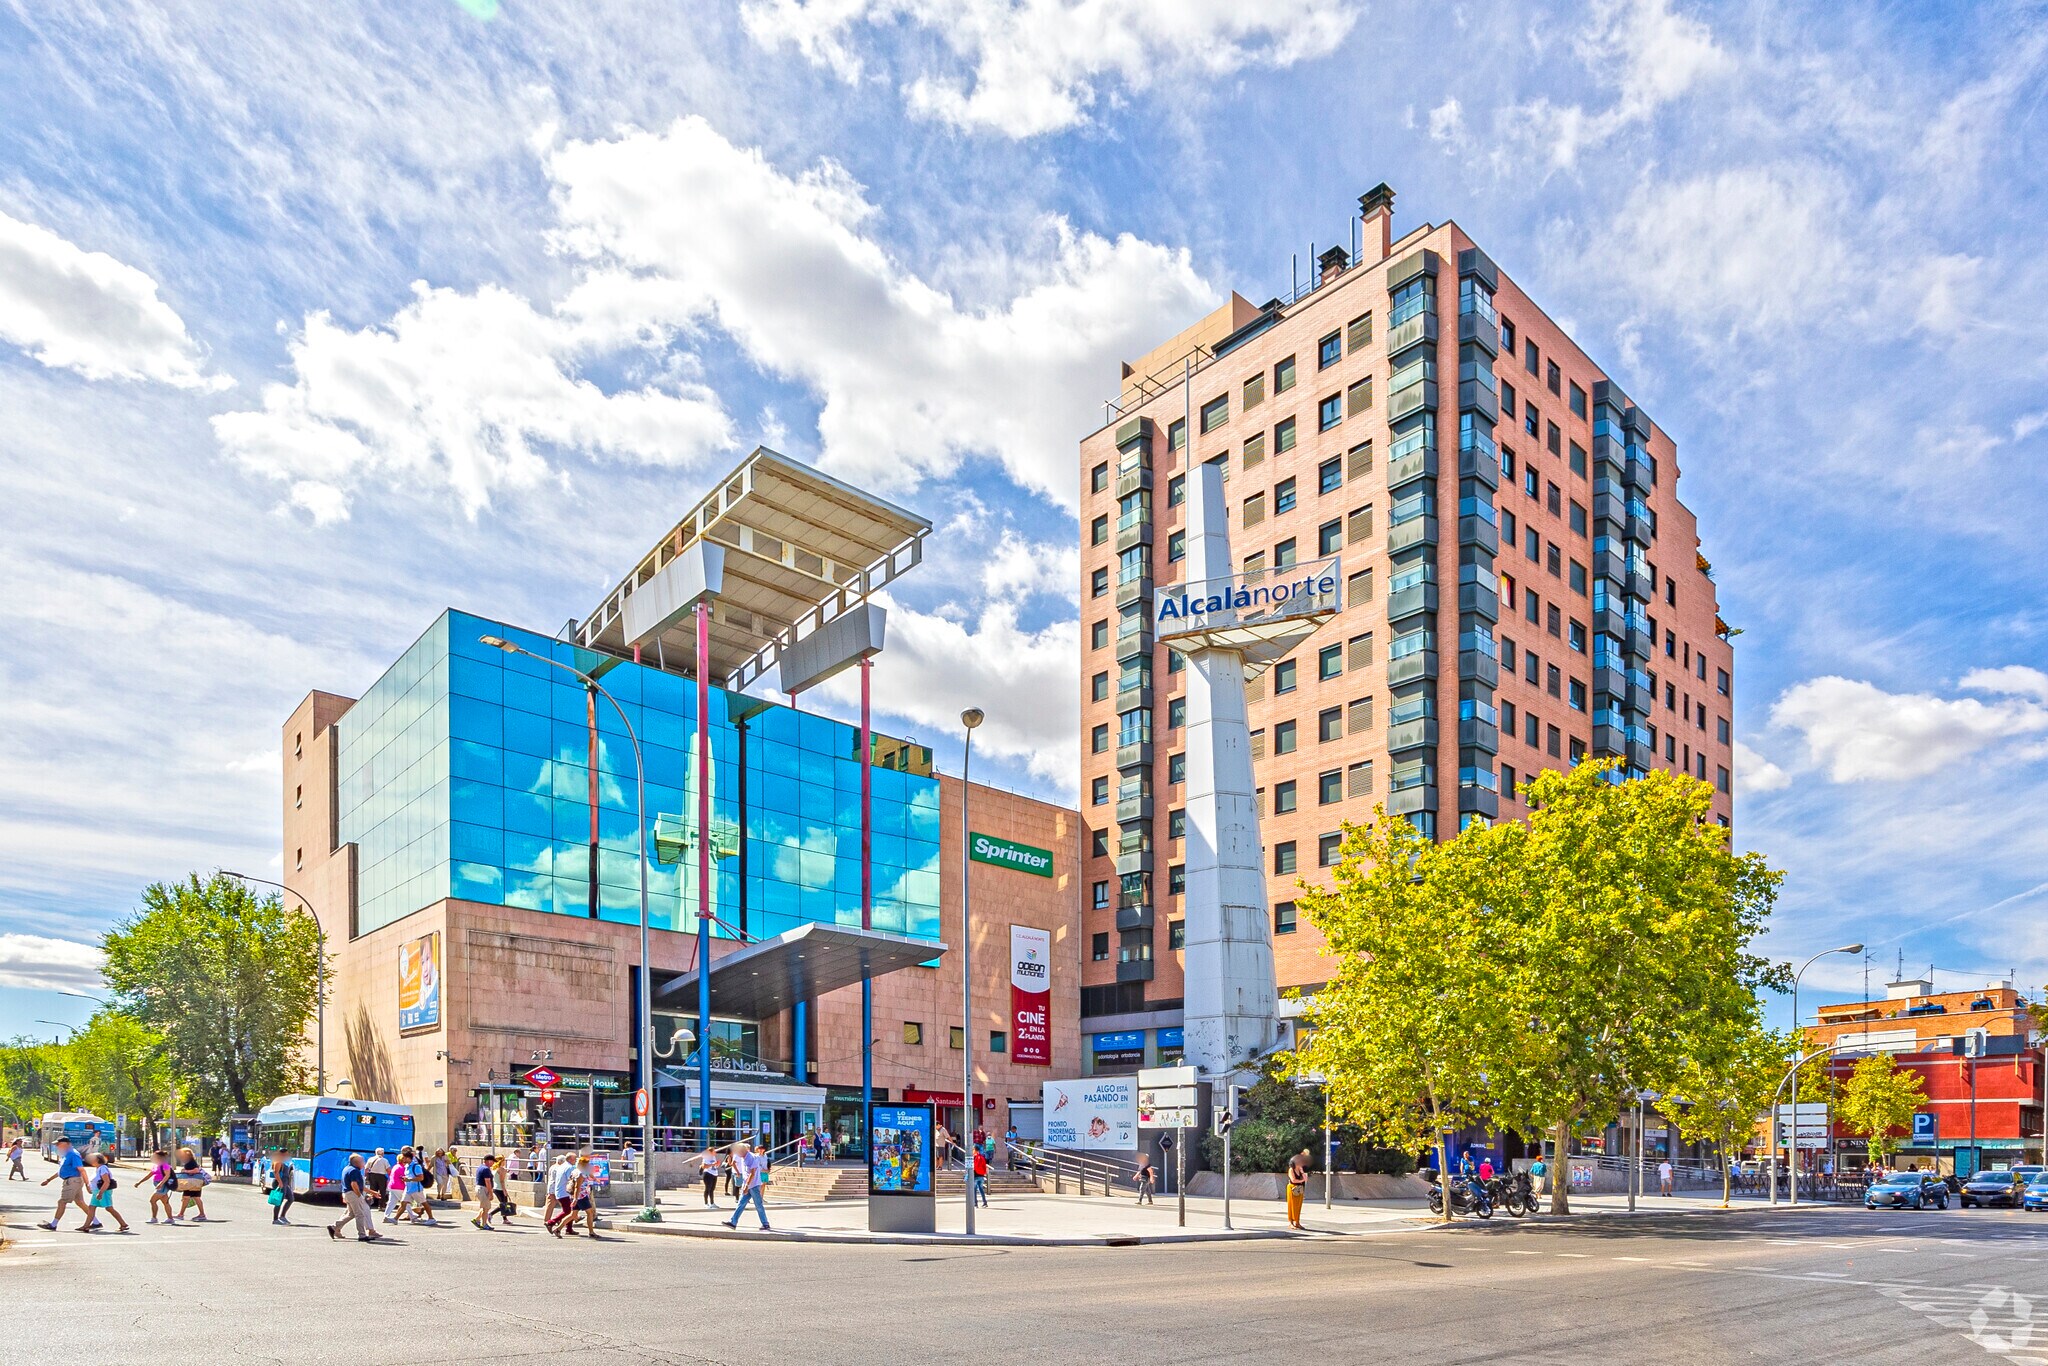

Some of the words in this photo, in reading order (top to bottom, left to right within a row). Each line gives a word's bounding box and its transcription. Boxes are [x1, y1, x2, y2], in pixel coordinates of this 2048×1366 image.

[975, 838, 1049, 868] Sprinter
[1018, 961, 1045, 973] ODEON
[1018, 1011, 1045, 1025] CINE
[1100, 1034, 1137, 1042] CES
[732, 1058, 767, 1072] Norte
[536, 1073, 552, 1081] Metro
[594, 1079, 619, 1088] House
[1096, 1085, 1115, 1093] ALGO
[935, 1097, 965, 1106] Santander
[1084, 1094, 1119, 1103] PASANDO
[1915, 1115, 1930, 1133] P
